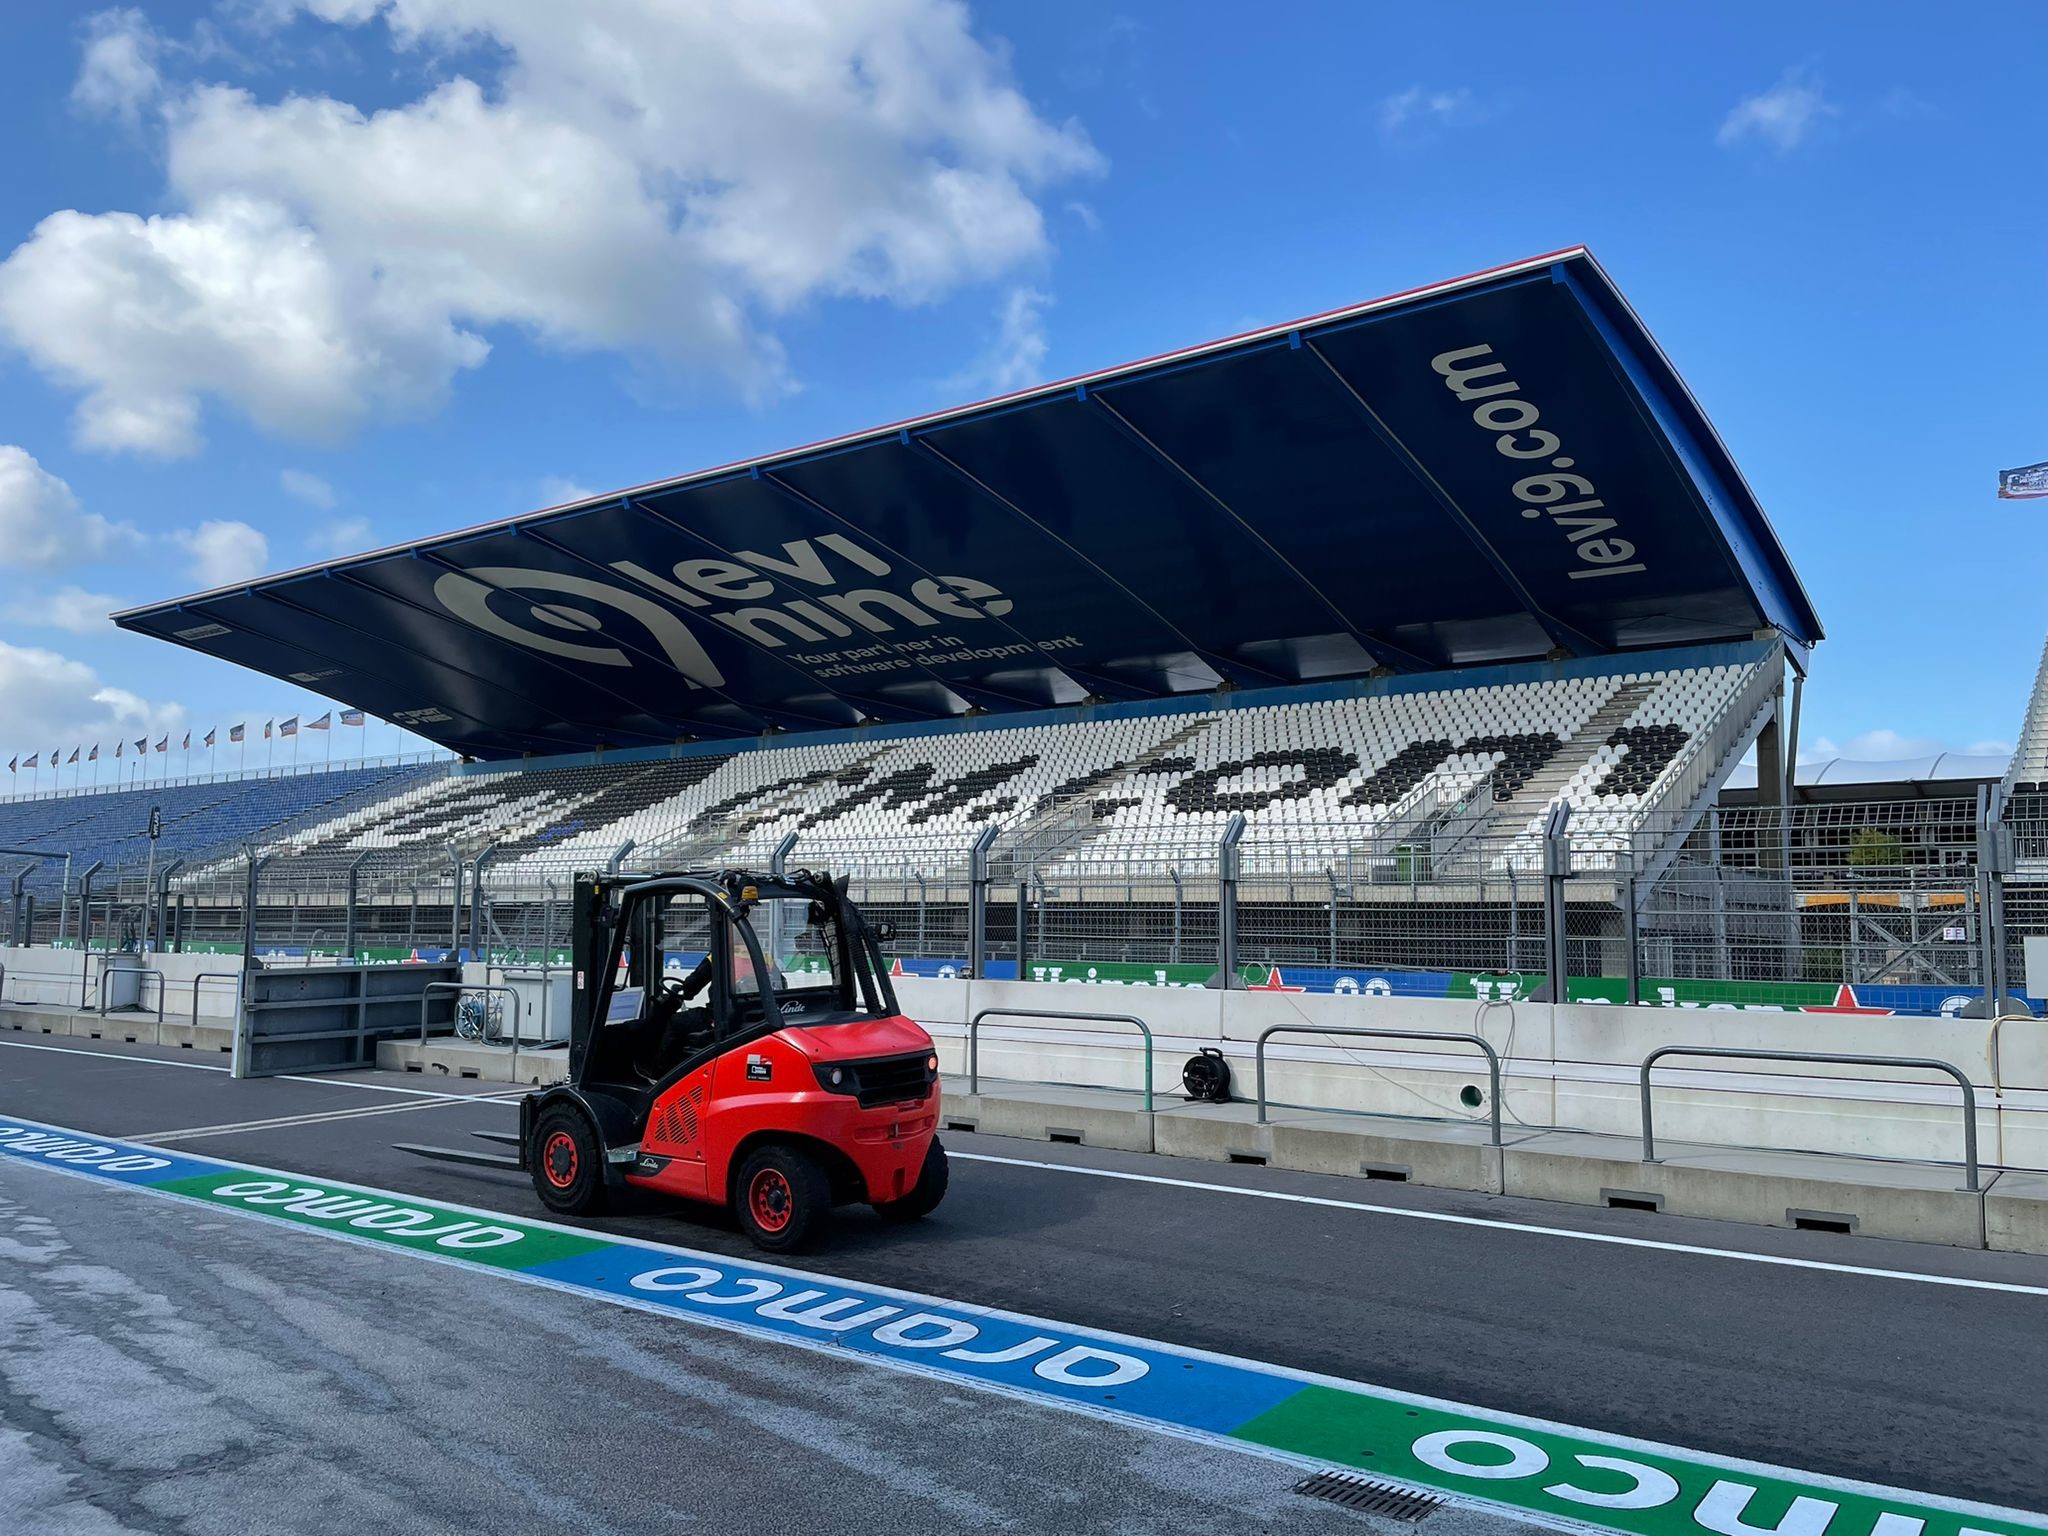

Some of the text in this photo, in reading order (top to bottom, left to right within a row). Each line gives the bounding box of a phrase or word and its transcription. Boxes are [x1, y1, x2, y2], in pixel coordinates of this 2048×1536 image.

[1431, 343, 1647, 580] levi9.com
[608, 533, 891, 607] levi
[710, 575, 1014, 648] nine
[787, 650, 842, 666] Your
[933, 633, 966, 648] in
[814, 634, 1084, 679] software development
[777, 1000, 806, 1015] Linde
[211, 1181, 525, 1248] aramco
[629, 1266, 1151, 1387] aramco
